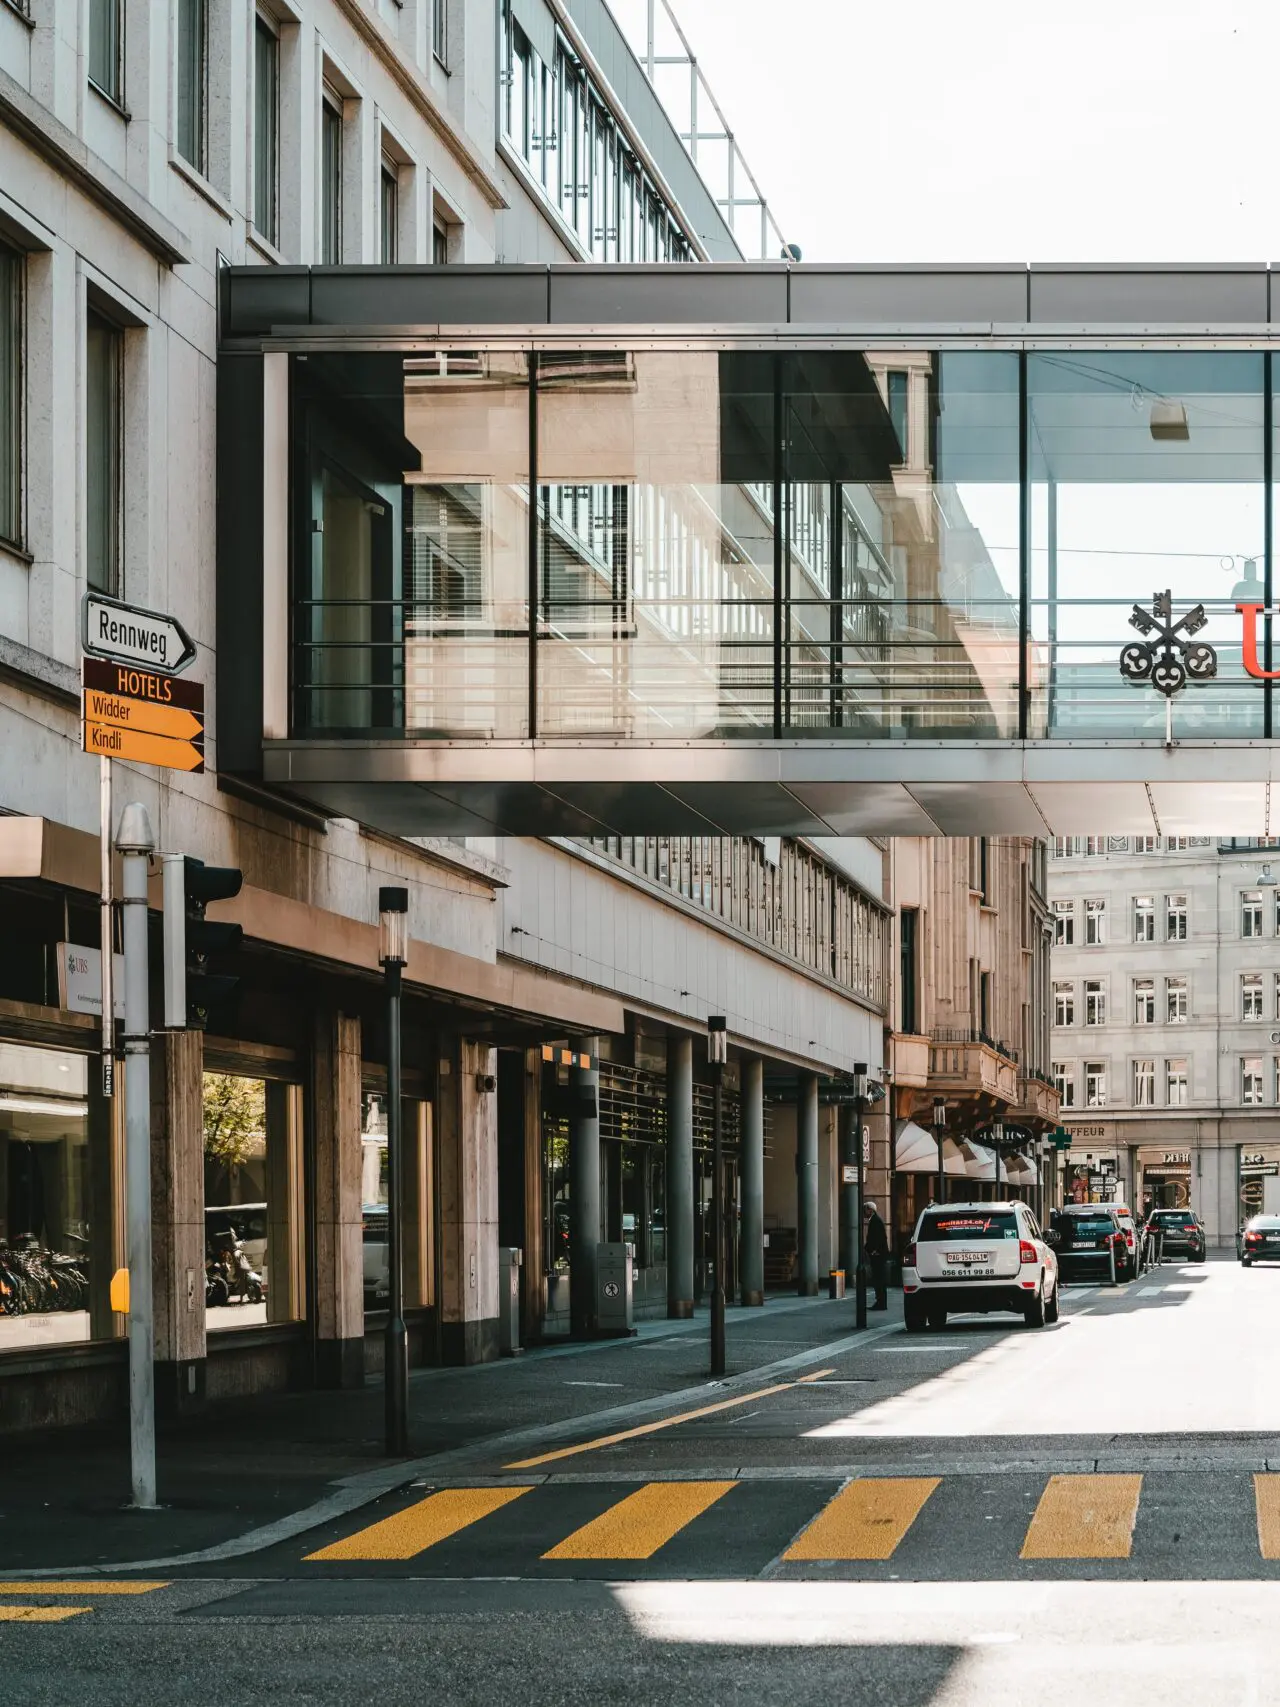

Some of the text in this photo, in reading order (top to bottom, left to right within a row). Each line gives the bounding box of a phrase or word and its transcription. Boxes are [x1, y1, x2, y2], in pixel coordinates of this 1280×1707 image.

[100, 610, 167, 663] Rennweg
[117, 668, 172, 702] HOTELS
[92, 695, 130, 721] Widder
[91, 728, 122, 751] Kindli
[75, 957, 88, 974] UBS
